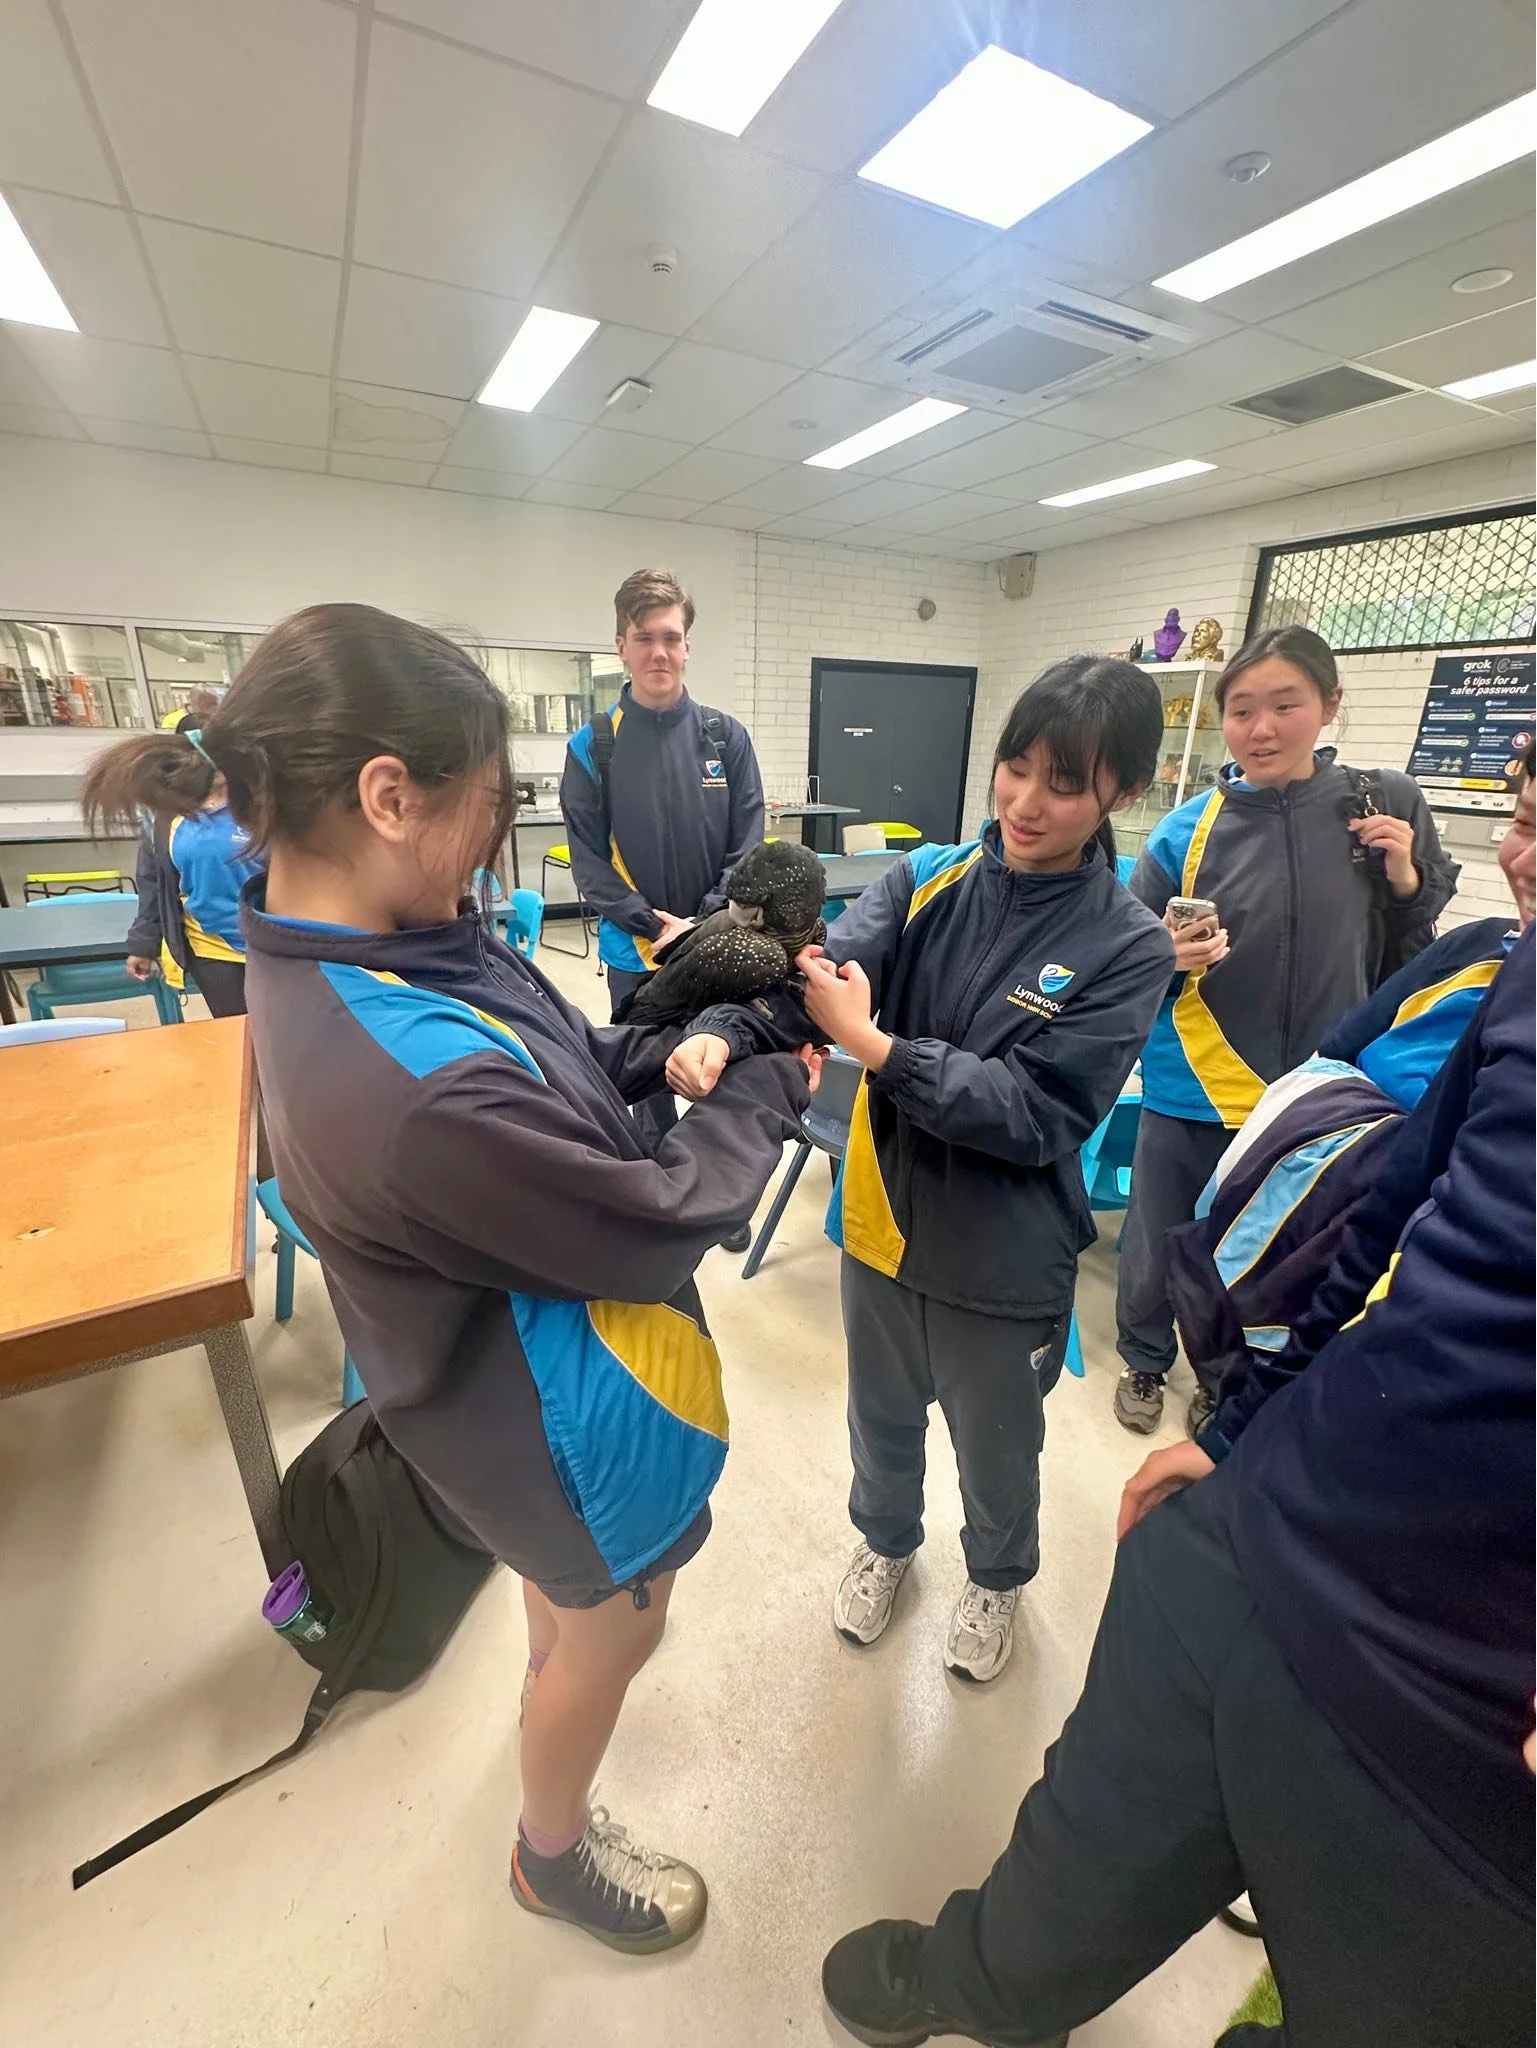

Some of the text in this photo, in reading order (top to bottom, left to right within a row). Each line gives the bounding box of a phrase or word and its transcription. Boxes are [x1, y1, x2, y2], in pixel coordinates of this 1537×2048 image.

[1463, 659, 1492, 673] grok
[1463, 675, 1519, 687] 6 tips for a
[1450, 684, 1529, 696] safer password
